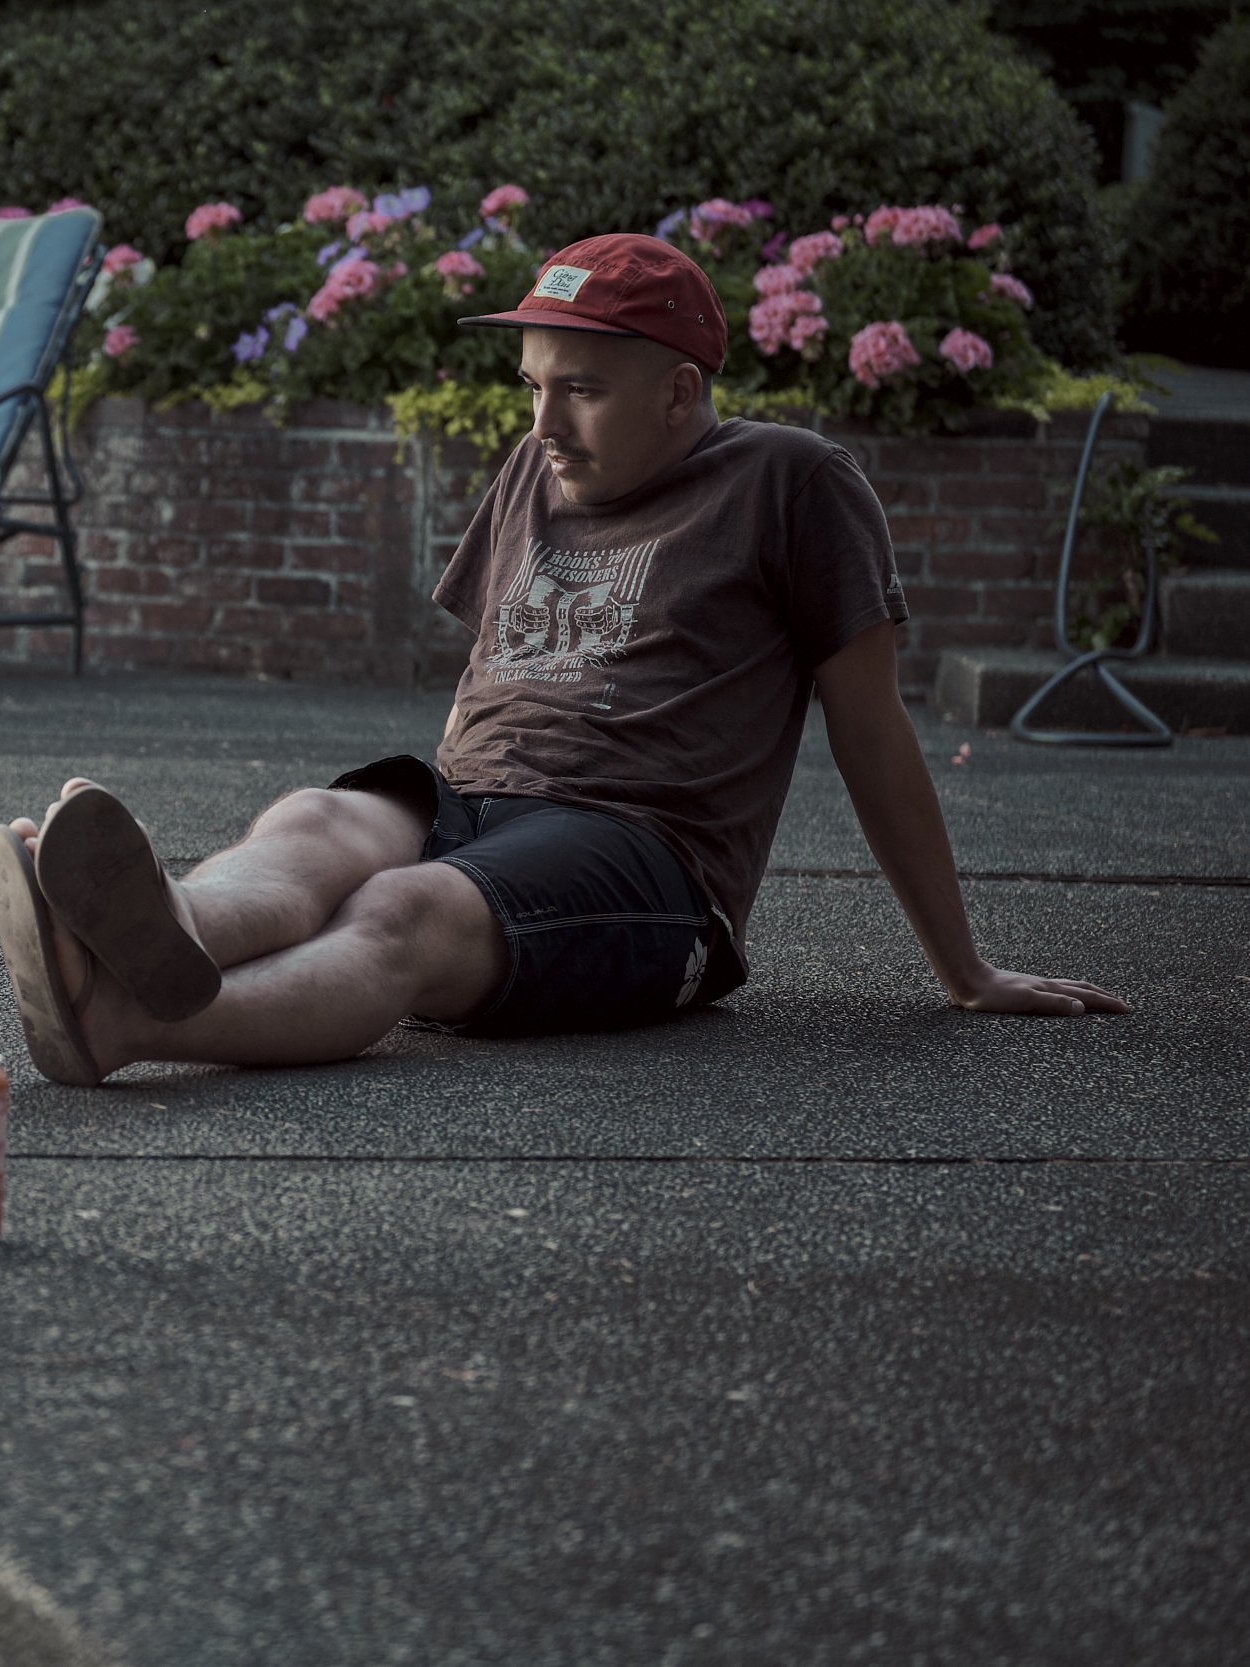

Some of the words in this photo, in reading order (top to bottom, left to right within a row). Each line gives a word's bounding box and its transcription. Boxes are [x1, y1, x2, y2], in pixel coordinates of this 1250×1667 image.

[547, 554, 602, 570] BOOKS
[606, 553, 625, 566] TO
[538, 563, 619, 583] PRISONERS
[494, 670, 582, 684] INCARCERATED
